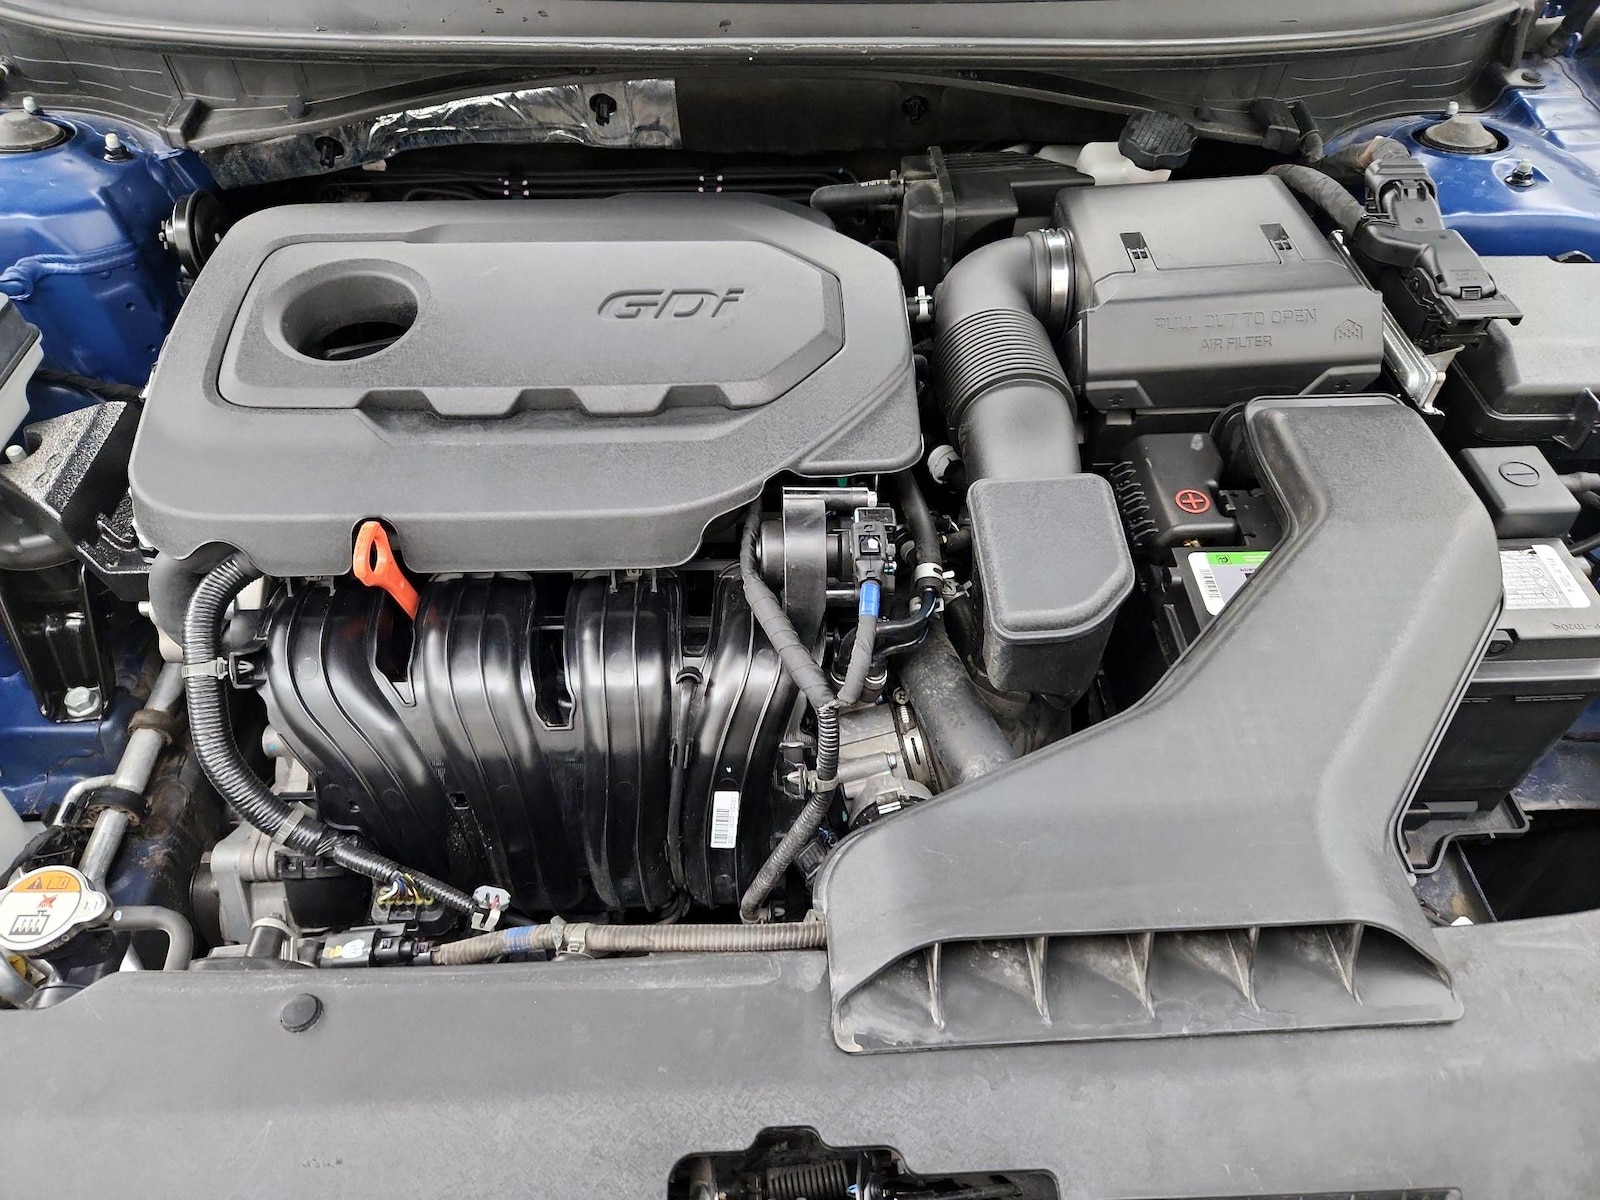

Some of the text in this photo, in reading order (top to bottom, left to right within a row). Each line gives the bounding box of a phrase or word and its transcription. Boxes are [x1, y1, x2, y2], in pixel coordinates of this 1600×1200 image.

[1154, 308, 1317, 332] PULL OUT TO OPEN
[1200, 335, 1273, 352] AIR FILTER
